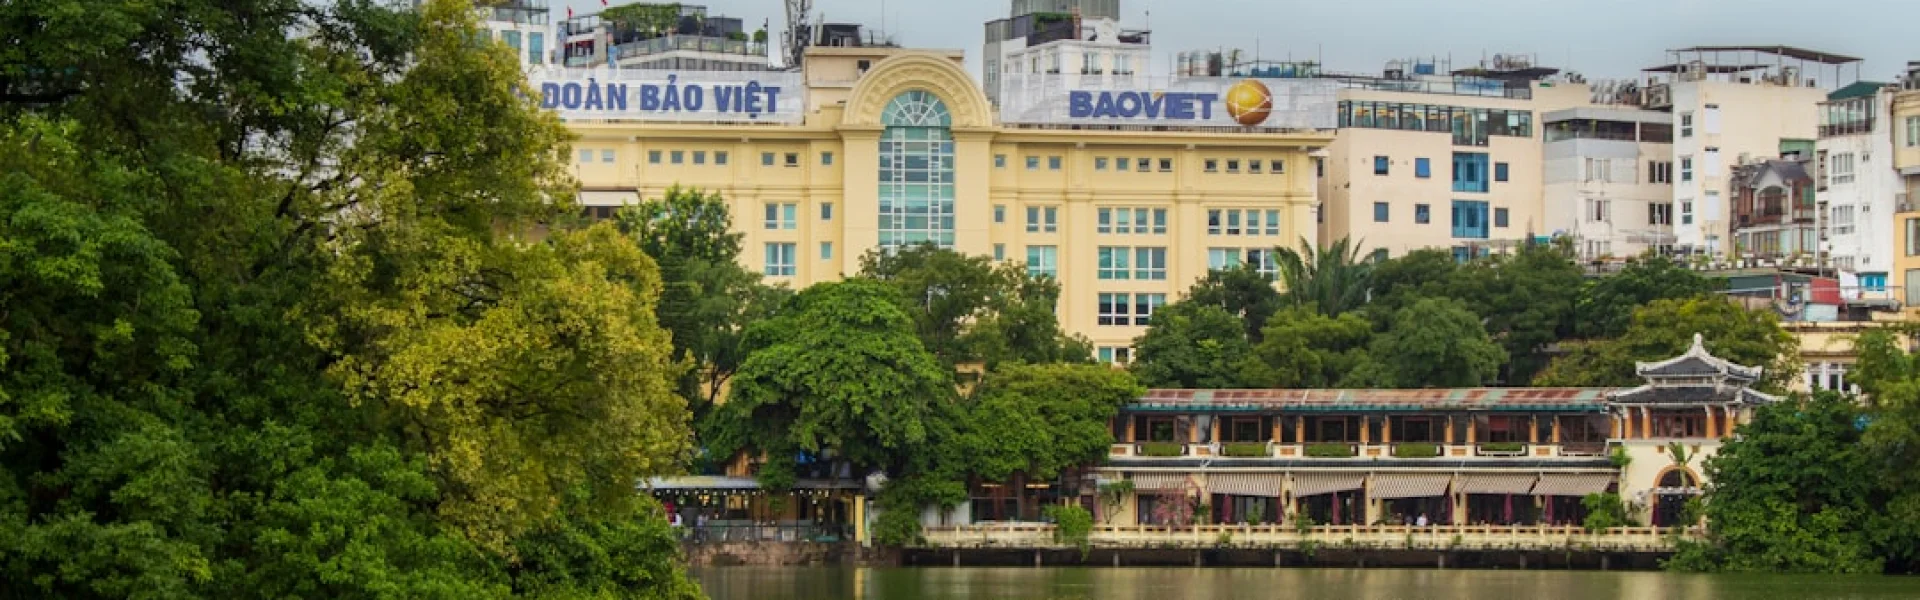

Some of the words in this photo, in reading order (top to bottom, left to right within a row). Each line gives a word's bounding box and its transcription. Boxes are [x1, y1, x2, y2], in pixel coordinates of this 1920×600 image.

[640, 74, 703, 111] BẢO
[714, 79, 781, 119] VIỆT
[1069, 90, 1218, 120] BAOVIET
